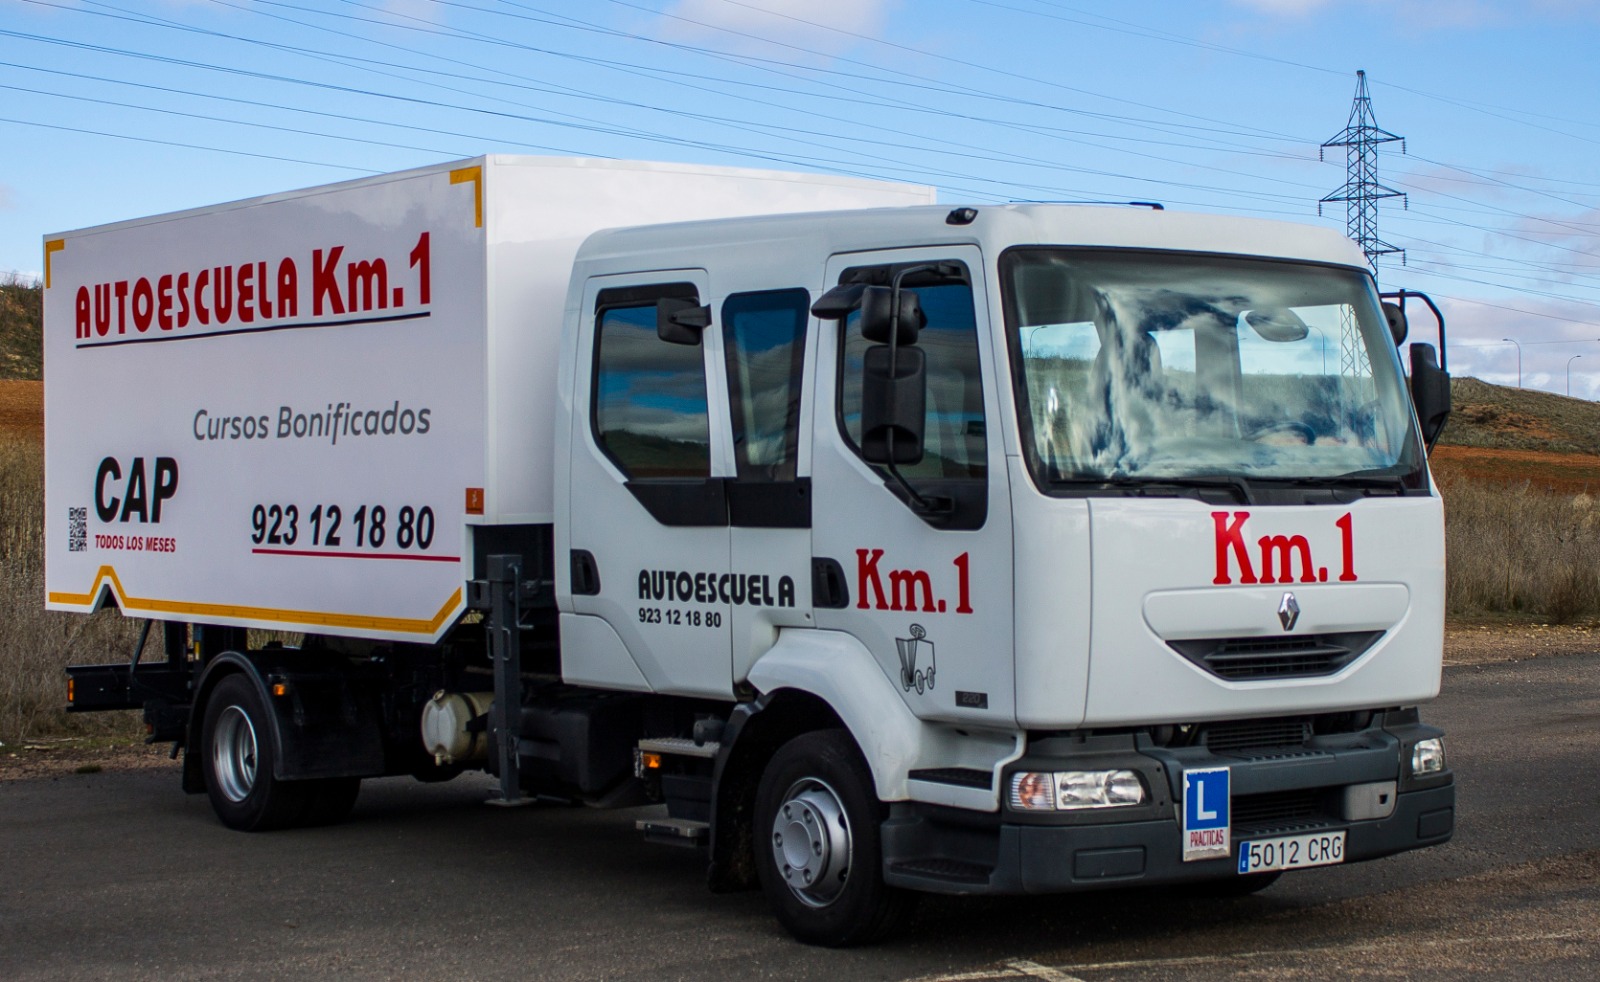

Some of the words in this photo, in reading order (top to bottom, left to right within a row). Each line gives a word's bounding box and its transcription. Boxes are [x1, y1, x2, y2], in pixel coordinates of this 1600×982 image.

[75, 257, 297, 338] AUTOESCUELA
[312, 231, 430, 316] Km.1
[193, 409, 269, 440] Cursos
[276, 401, 431, 445] Bonificados
[94, 456, 179, 525] CAP
[95, 534, 124, 551] TODOS
[126, 536, 143, 551] LOS
[145, 537, 176, 553] MESES
[251, 503, 299, 546] 923
[309, 504, 342, 547] 12
[352, 505, 386, 548] 18
[396, 505, 435, 550] 80
[1211, 511, 1358, 585] Km.1
[638, 569, 795, 607] AUTOESCUELA
[855, 548, 974, 614] Km.1
[638, 608, 661, 624] 923
[666, 609, 681, 625] 12
[685, 610, 701, 627] 18
[704, 611, 722, 628] 80
[1197, 780, 1217, 821] L
[1250, 840, 1300, 868] 5012
[1308, 836, 1341, 862] CRG
